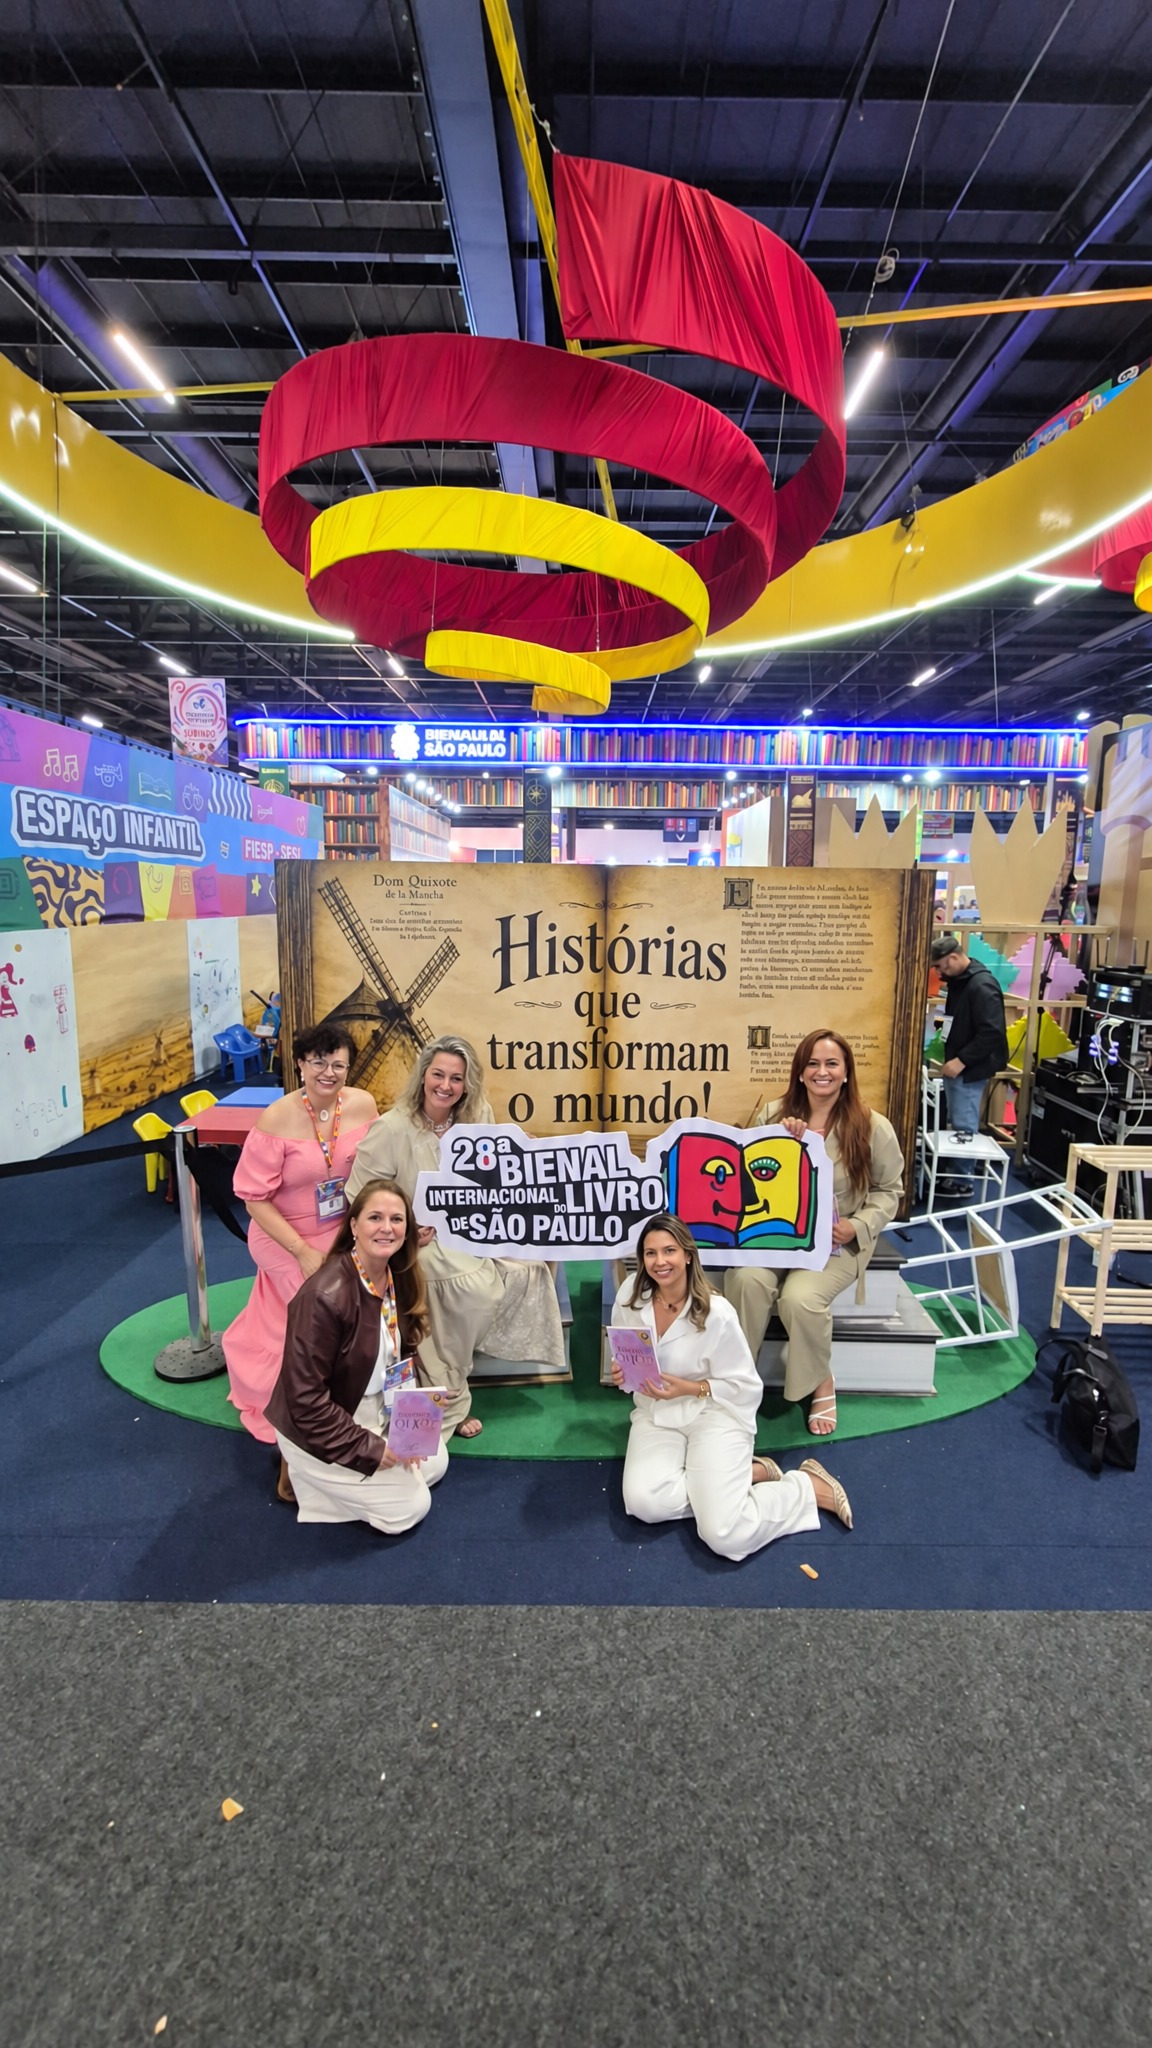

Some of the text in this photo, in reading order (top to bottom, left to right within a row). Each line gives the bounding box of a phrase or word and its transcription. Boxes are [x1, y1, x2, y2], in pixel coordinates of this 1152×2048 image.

[424, 740, 507, 757] SÃO PAULO
[18, 793, 202, 852] ESPAÇO INFANTIL
[244, 839, 274, 861] FIESP
[280, 844, 302, 860] SESI
[373, 874, 458, 889] Dom Quixote
[385, 889, 444, 899] de la Mancha
[492, 910, 728, 994] Histórias
[574, 990, 641, 1027] que
[486, 1026, 730, 1072] transformam
[508, 1080, 712, 1124] o mundo!
[498, 1143, 629, 1188] BIENAL
[428, 1178, 664, 1214] INTERNACIONAL DO LIVRO
[450, 1207, 623, 1243] DE SÃO PAULO
